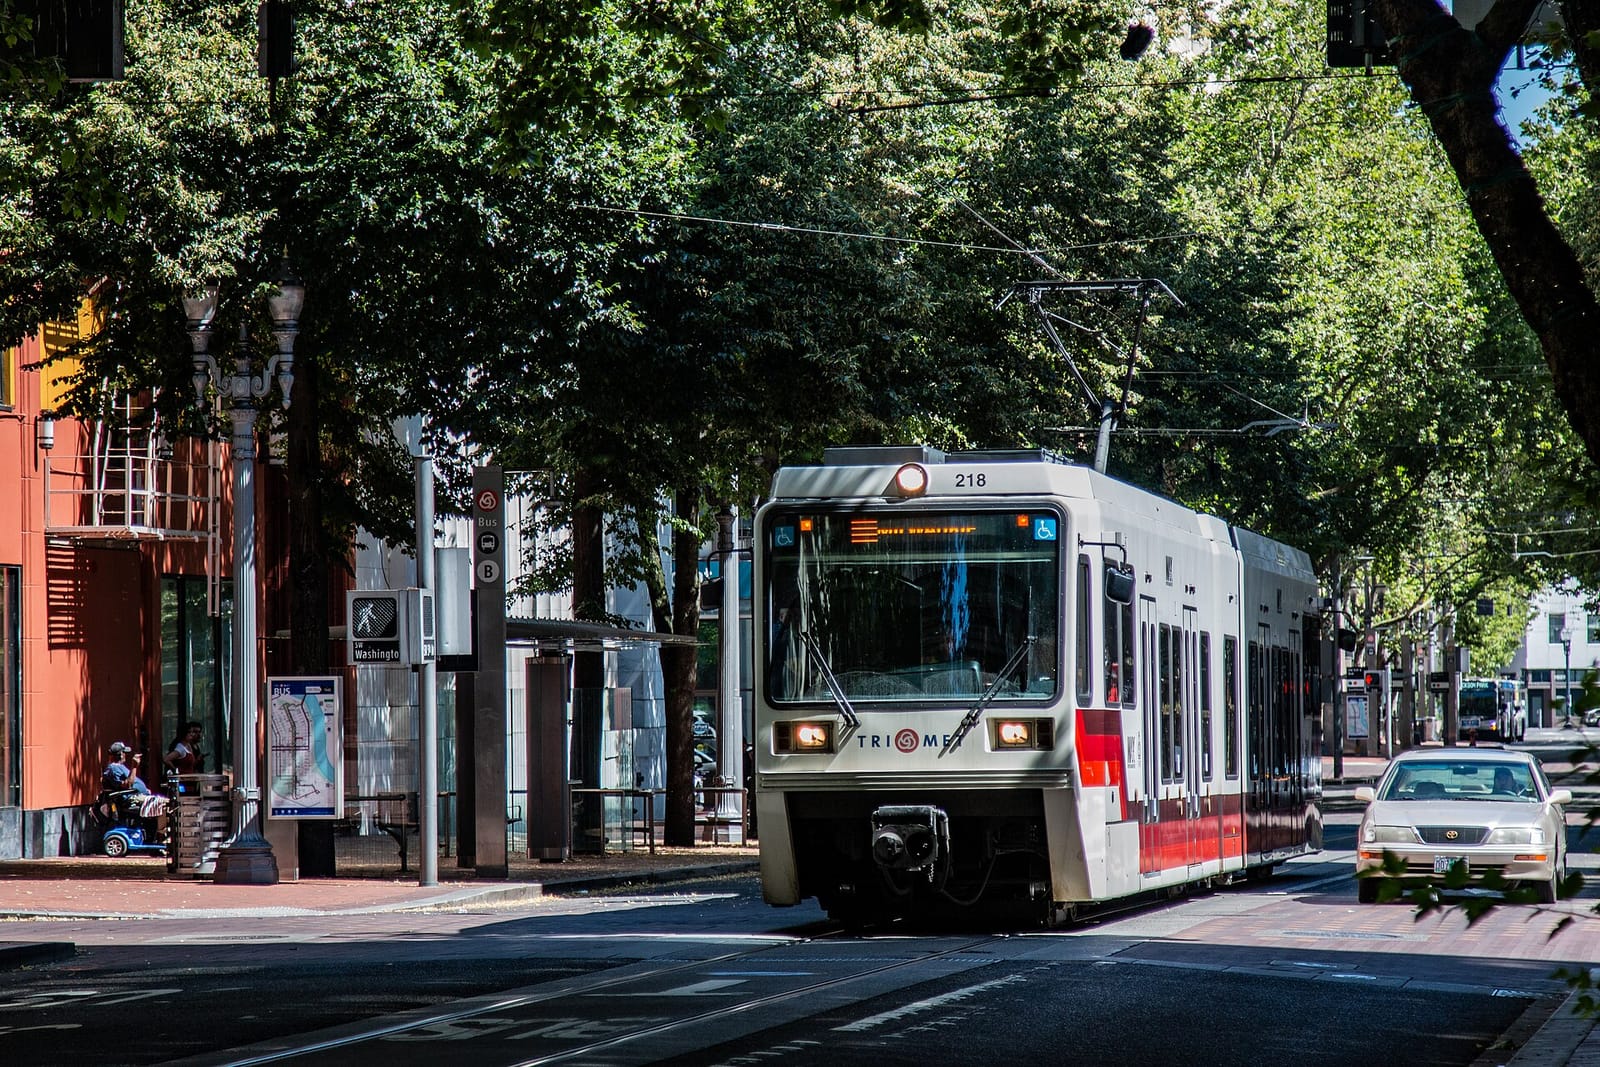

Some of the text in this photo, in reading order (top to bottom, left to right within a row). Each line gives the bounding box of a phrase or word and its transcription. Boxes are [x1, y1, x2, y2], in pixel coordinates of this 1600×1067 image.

[955, 473, 987, 488] 218
[478, 517, 497, 527] Bus
[484, 565, 493, 578] B
[355, 649, 399, 661] Washingto
[274, 687, 291, 695] BUS
[857, 735, 890, 748] TRI
